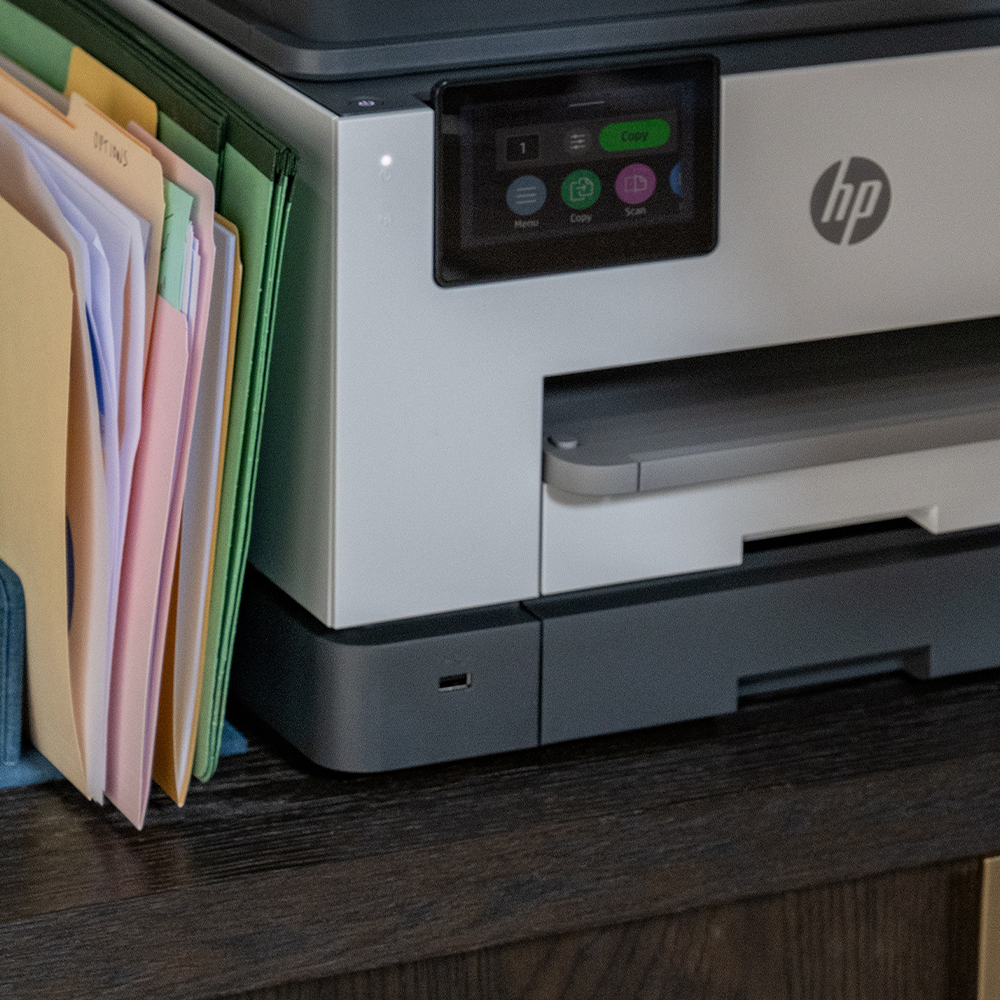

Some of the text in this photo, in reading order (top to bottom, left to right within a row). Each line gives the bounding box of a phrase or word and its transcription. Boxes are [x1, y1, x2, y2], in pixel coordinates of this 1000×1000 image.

[620, 130, 649, 143] Copy
[810, 156, 891, 246] hp
[513, 205, 647, 230] Menu Copy Scan
